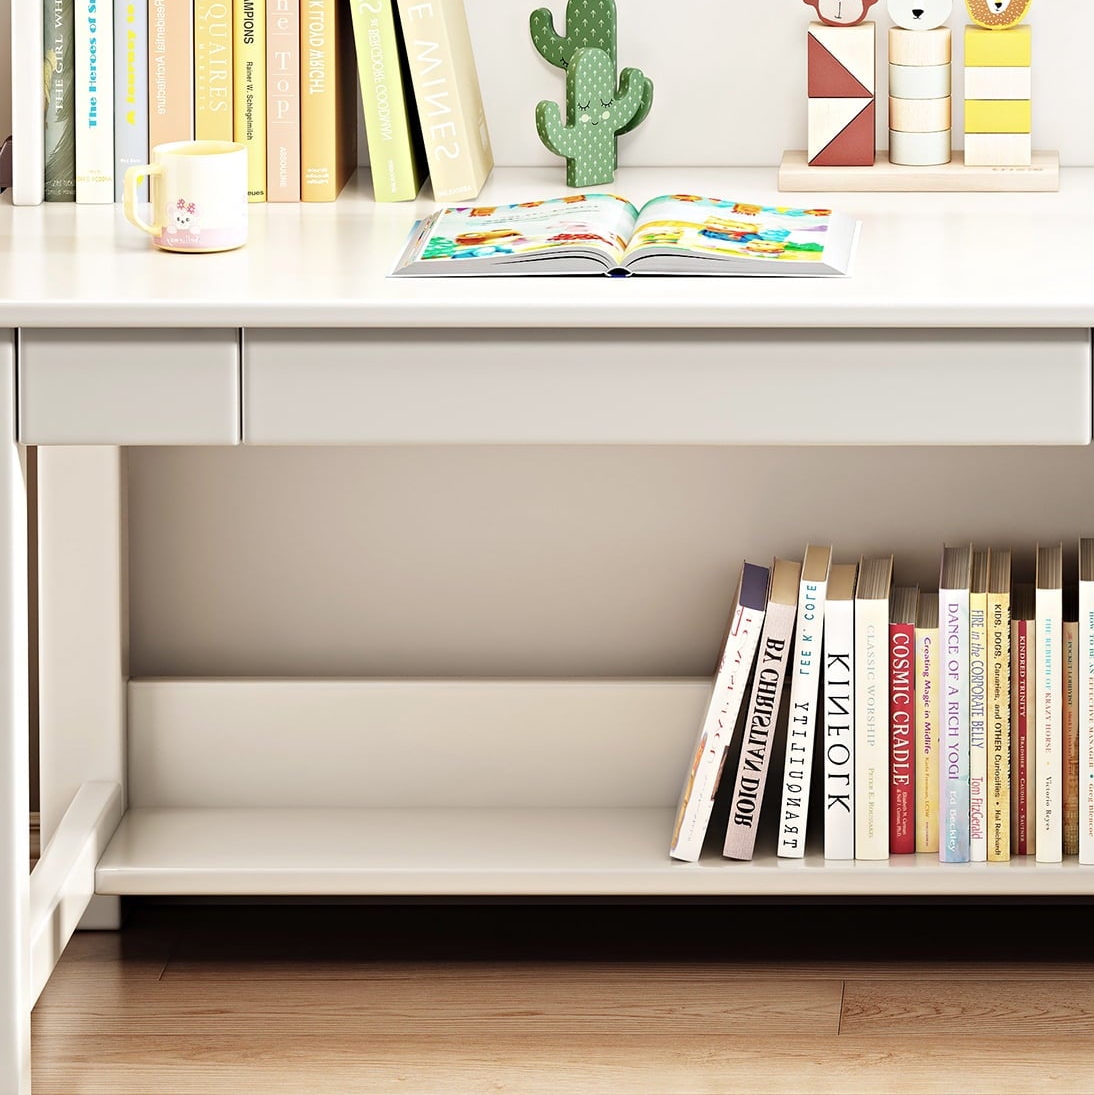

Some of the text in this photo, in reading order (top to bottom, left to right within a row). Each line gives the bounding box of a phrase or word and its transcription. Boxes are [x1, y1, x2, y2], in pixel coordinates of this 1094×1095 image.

[272, 50, 292, 121] Top
[866, 624, 876, 746] CLASSIC WORSHIP
[892, 632, 910, 786] COSMIC CRADLE
[947, 603, 960, 780] DANCE OF A RICH YOGI
[971, 610, 984, 749] FIRE in the CORPORATE BELLY
[993, 604, 1002, 798] KIDS, DOGS, Canaries, and OTHER Curiosities
[946, 791, 958, 852] Ed Beckley
[971, 777, 984, 840] Tom FitzGerald
